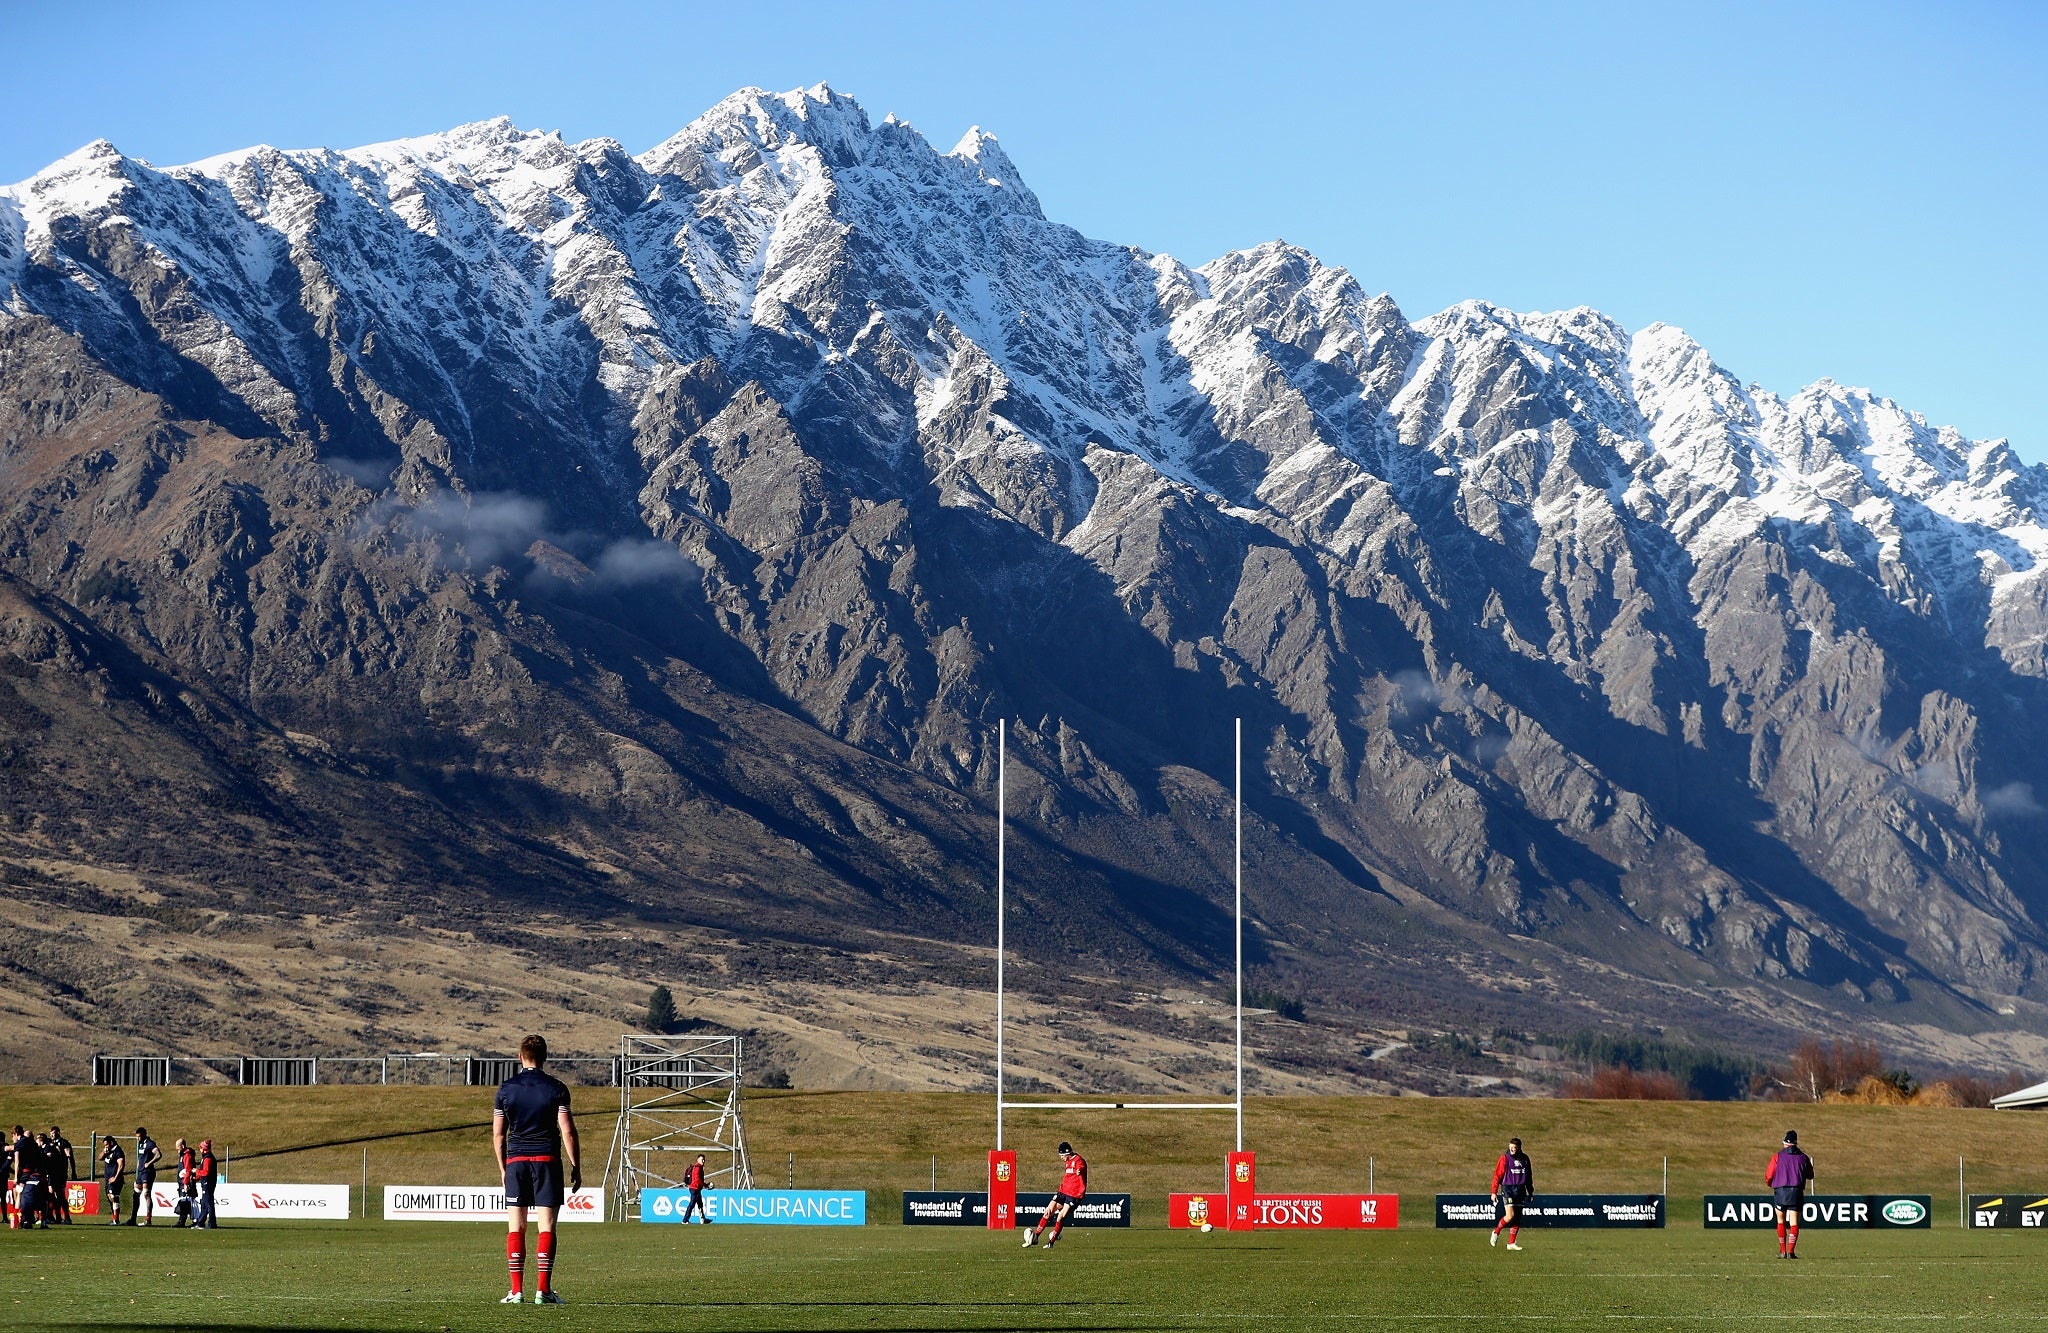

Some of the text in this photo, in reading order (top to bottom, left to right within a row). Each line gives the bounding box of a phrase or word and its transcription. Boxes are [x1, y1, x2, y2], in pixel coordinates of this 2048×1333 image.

[268, 1198, 327, 1207] QANTAS
[394, 1193, 508, 1210] COMMITTED TO TH
[909, 1202, 962, 1211] Standard Life
[1262, 1199, 1292, 1207] BRITISH
[1301, 1199, 1322, 1207] IRISH
[722, 1196, 854, 1219] INSURANCE
[972, 1206, 987, 1214] ONE
[1014, 1206, 1024, 1214] NE
[997, 1204, 1008, 1214] NZ
[1076, 1203, 1122, 1212] andard Life
[1236, 1205, 1247, 1215] NZ
[1361, 1200, 1377, 1216] NZ
[1442, 1204, 1496, 1214] Standard Life
[1543, 1207, 1558, 1216] ONE
[1602, 1204, 1656, 1214] Standard Life
[1707, 1202, 1868, 1222] LAND OVER
[914, 1209, 962, 1218] Investments
[1073, 1211, 1122, 1219] Investments
[1253, 1205, 1323, 1225] IONS
[1447, 1212, 1496, 1220] Investments
[1607, 1212, 1656, 1220] Investments
[1975, 1211, 1998, 1227] EY
[2021, 1211, 2045, 1227] EY
